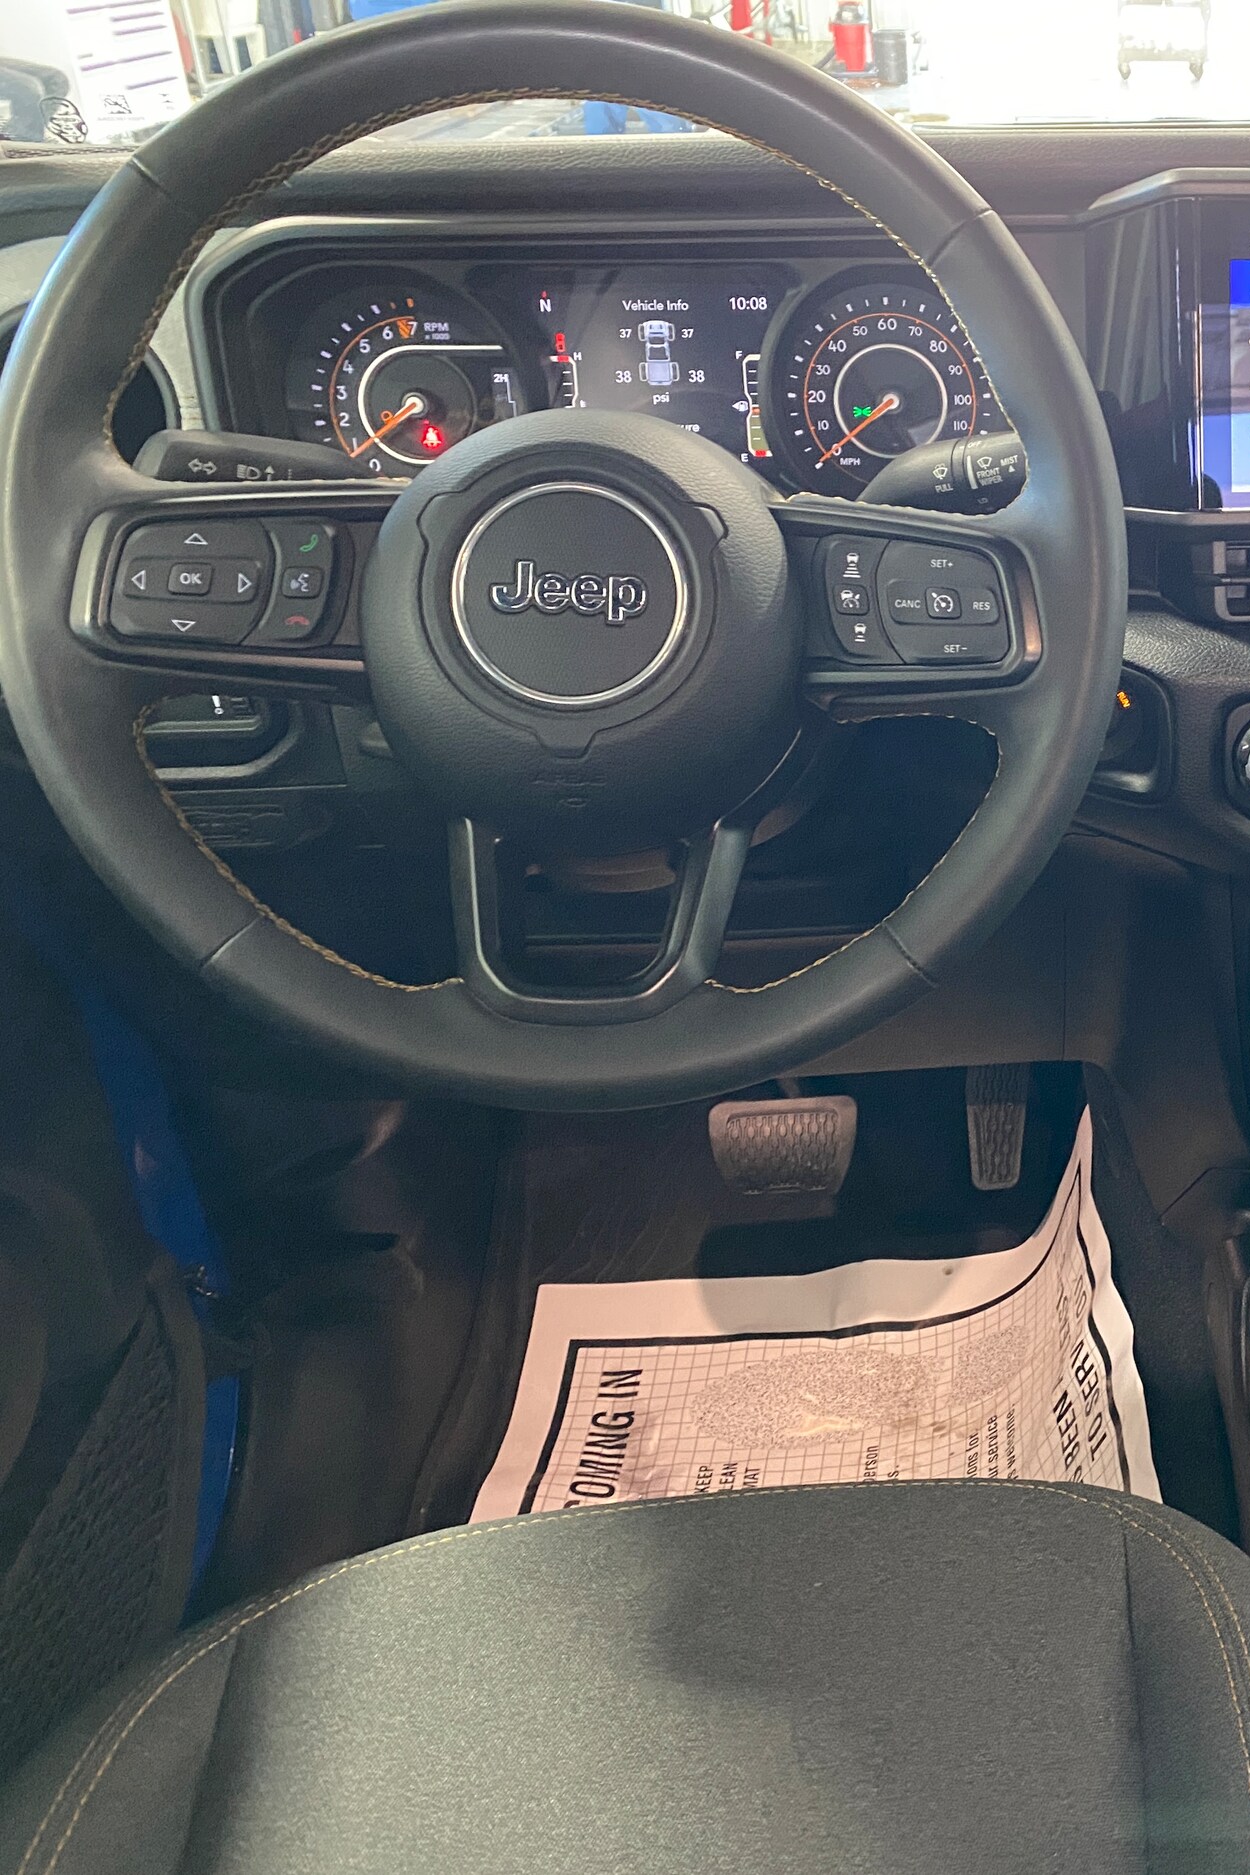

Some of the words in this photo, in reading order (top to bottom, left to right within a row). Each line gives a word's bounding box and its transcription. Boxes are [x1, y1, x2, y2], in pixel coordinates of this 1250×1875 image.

[540, 300, 551, 312] N
[622, 300, 664, 311] Vehicle
[667, 300, 689, 311] Info
[729, 296, 768, 310] 10:08
[408, 321, 418, 335] 7
[424, 322, 449, 331] RPM
[877, 318, 897, 331] 60
[383, 326, 393, 340] 6
[619, 329, 632, 339] 37
[681, 329, 694, 339] 37
[852, 326, 868, 336] 50
[908, 326, 923, 336] 70
[359, 339, 370, 353] 5
[828, 340, 846, 352] 40
[929, 341, 948, 353] 80
[573, 351, 582, 361] H
[736, 351, 742, 360] F
[343, 360, 354, 374] 4
[815, 365, 831, 375] 30
[948, 365, 963, 376] 90
[494, 373, 509, 383] 2H
[615, 370, 632, 383] 38
[688, 370, 705, 383] 38
[336, 386, 347, 400] 3
[653, 392, 670, 404] psi
[808, 390, 826, 403] 20
[954, 395, 972, 405] 100
[339, 412, 350, 427] 2
[817, 420, 829, 430] 10
[953, 420, 968, 430] 110
[741, 453, 749, 463] E
[840, 458, 860, 466] MPH
[1000, 455, 1018, 466] MIST
[369, 459, 381, 472] 0
[976, 467, 1000, 479] FRONT
[978, 475, 1003, 486] WIPER
[935, 483, 954, 493] PULL
[180, 573, 202, 585] OK
[491, 560, 647, 625] Jeep
[895, 599, 921, 608] CANC
[972, 602, 991, 611] RES
[1069, 1338, 1100, 1412] SERV
[597, 1368, 643, 1398] IN
[1004, 1403, 1016, 1468] welcome.
[1052, 1390, 1080, 1470] BEEN
[965, 1434, 979, 1450] for
[986, 1415, 998, 1461] service
[1087, 1412, 1107, 1461] TO
[694, 1465, 713, 1494] KEEP
[719, 1463, 738, 1490] LEAN
